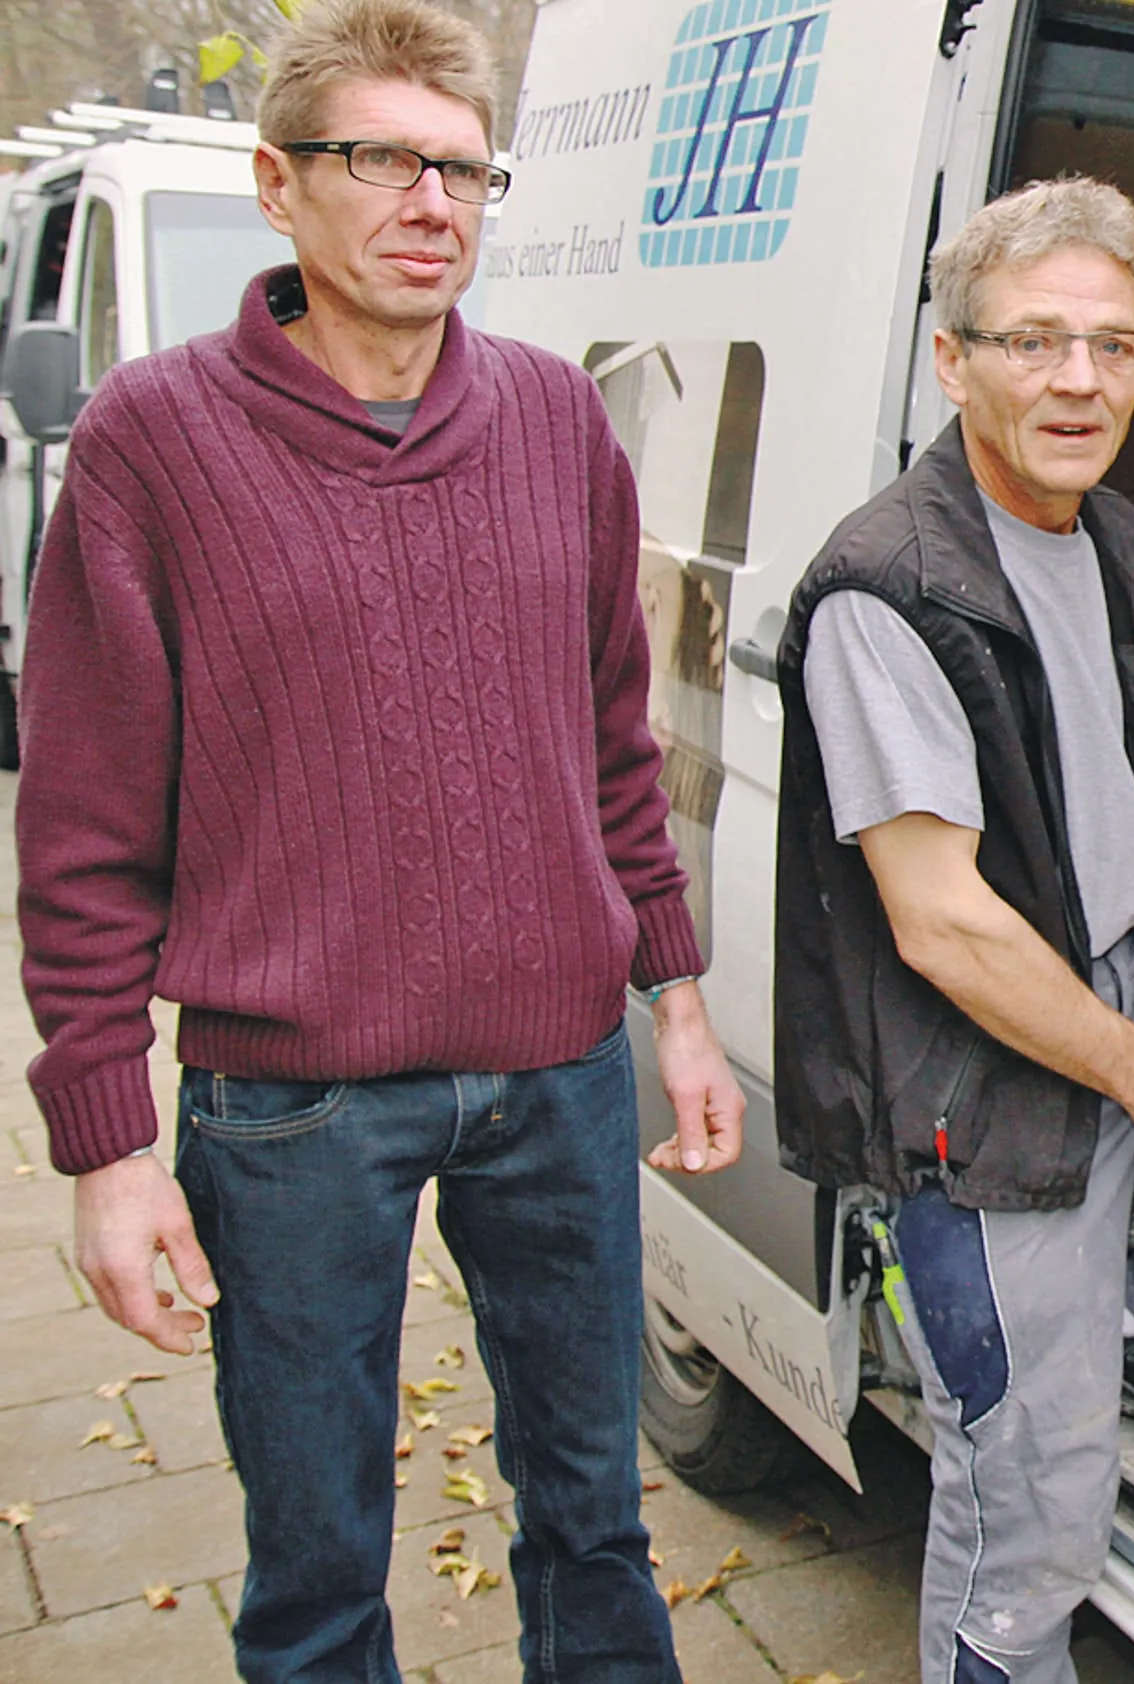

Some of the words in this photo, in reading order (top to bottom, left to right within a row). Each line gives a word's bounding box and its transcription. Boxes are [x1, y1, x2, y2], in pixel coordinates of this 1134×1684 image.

[653, 15, 819, 226] JH
[518, 226, 564, 276] einer
[566, 220, 625, 276] Hand
